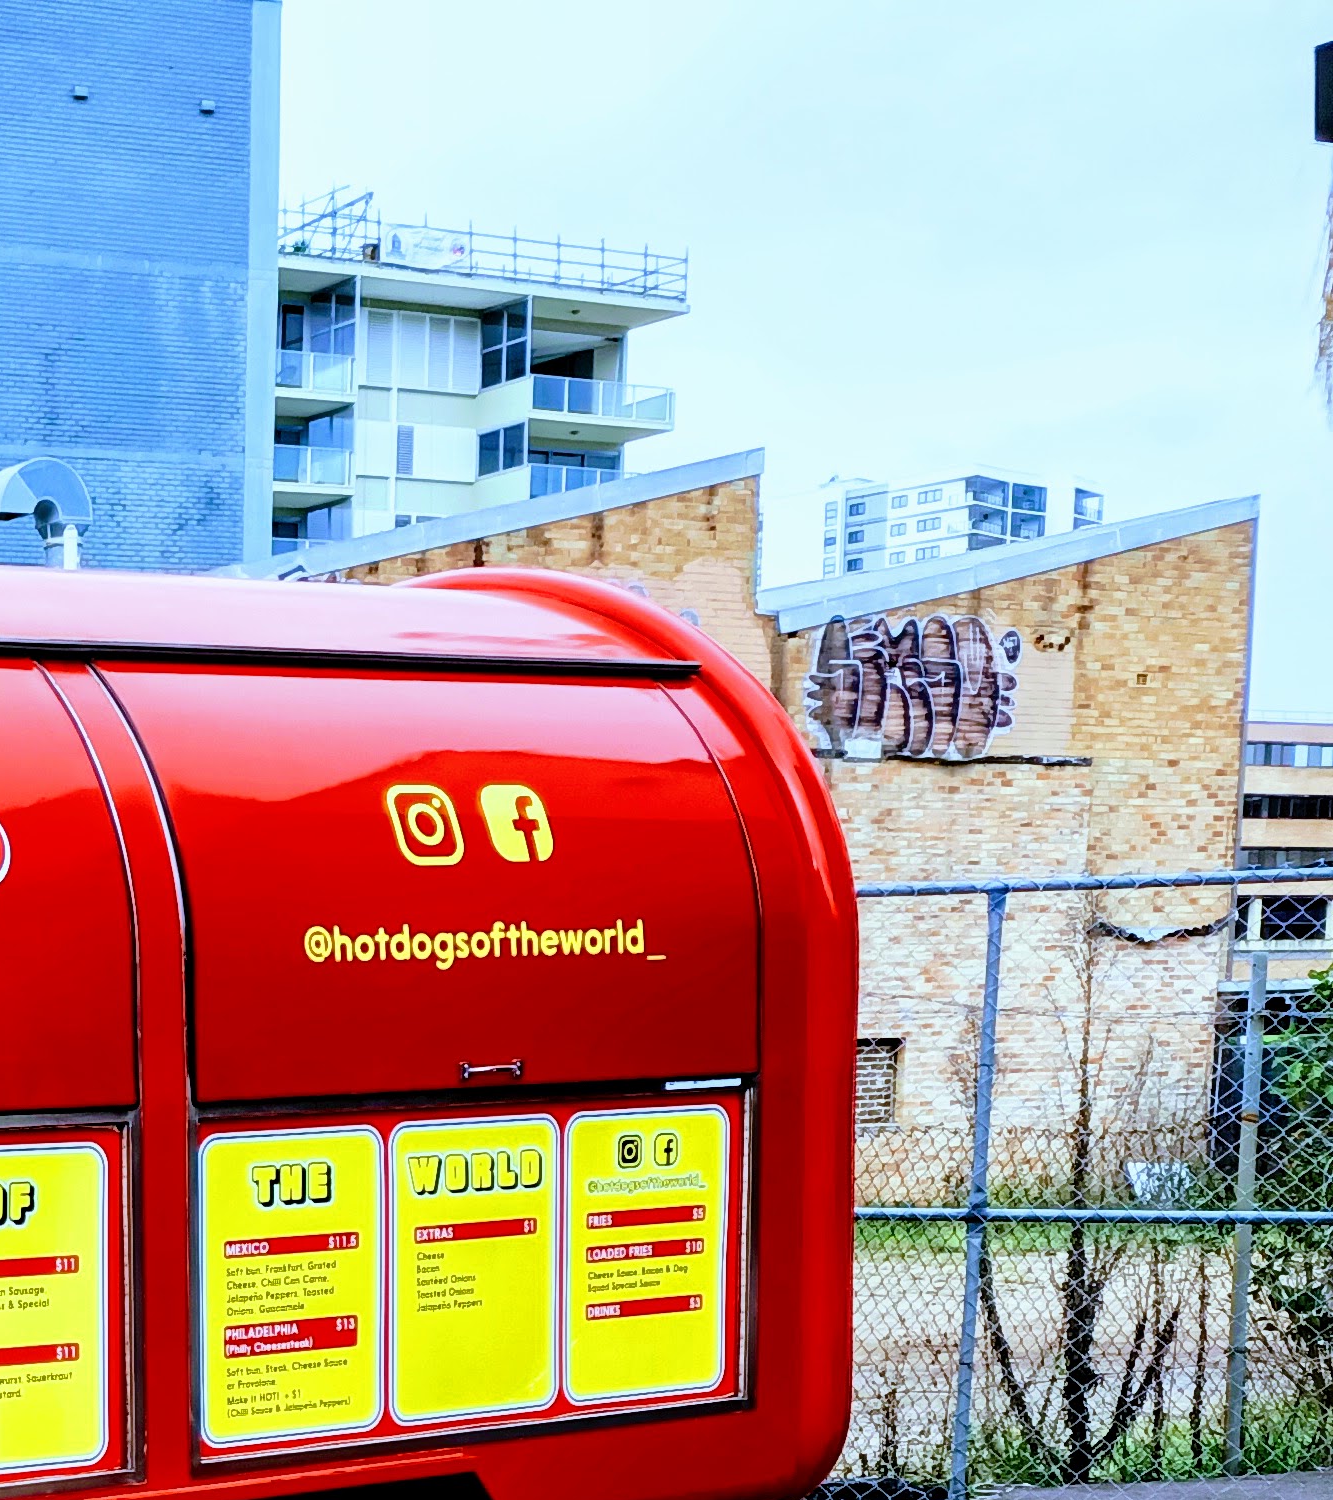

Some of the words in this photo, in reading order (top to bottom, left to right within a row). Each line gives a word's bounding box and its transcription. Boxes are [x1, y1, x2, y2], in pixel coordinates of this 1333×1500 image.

[304, 918, 667, 971] @hotdogsoftheworld_
[408, 1149, 542, 1195] WORLD
[251, 1162, 332, 1207] THE
[588, 1215, 612, 1227] FRIES
[692, 1208, 703, 1219] $5
[416, 1227, 453, 1241] EXTRAS
[523, 1220, 534, 1233] $1
[226, 1242, 269, 1256] MEXICO
[328, 1235, 357, 1248] $11.5
[588, 1247, 626, 1260] LOADED
[629, 1245, 652, 1256] FRIES
[685, 1241, 702, 1253] $10
[55, 1258, 75, 1272] $11
[9, 1301, 14, 1309] &
[18, 1300, 49, 1311] Special
[588, 1305, 620, 1318] DRINKS
[226, 1323, 298, 1341] PHILADELPHIA
[336, 1318, 355, 1331] $13
[56, 1346, 76, 1360] $11
